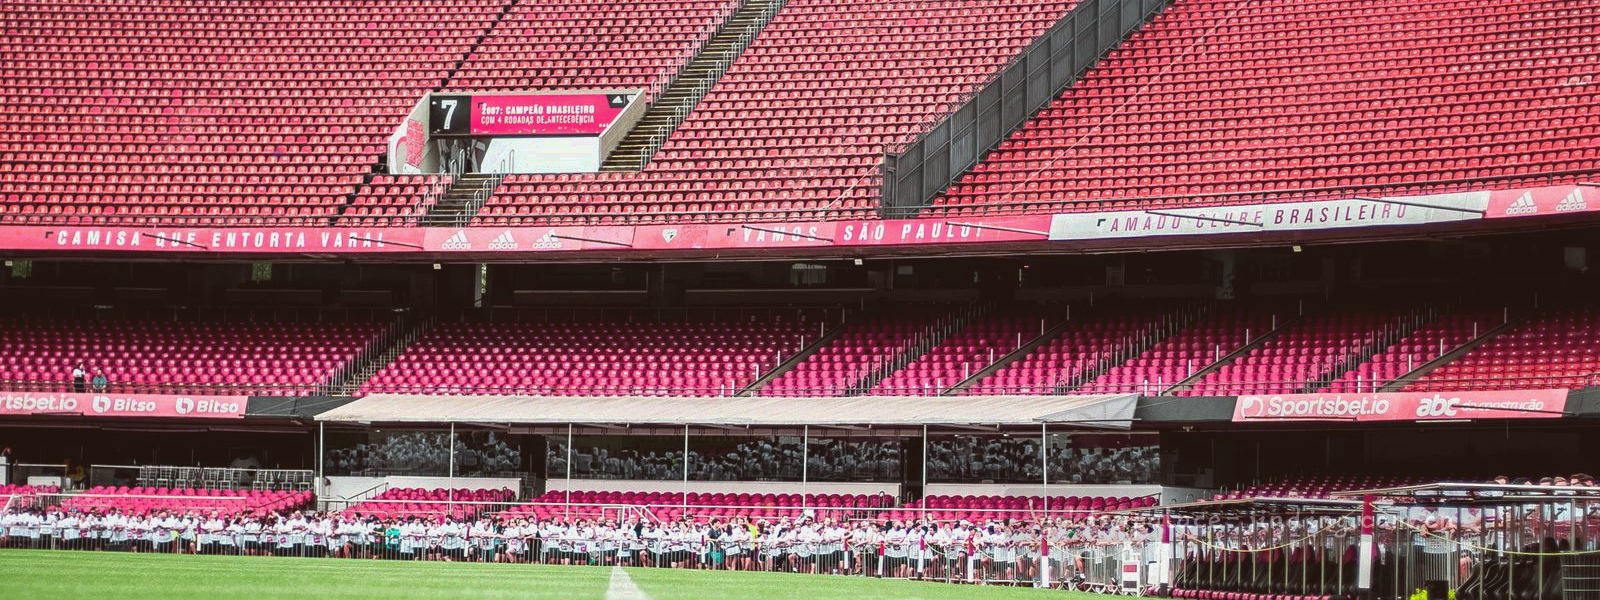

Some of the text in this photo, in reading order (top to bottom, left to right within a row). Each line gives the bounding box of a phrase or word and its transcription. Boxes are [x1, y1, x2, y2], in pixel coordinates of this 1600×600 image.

[441, 99, 458, 130] 7
[505, 104, 544, 115] CAMPEÃO
[546, 105, 595, 115] BRASILEIRO
[480, 116, 496, 126] COM
[497, 116, 502, 124] 4
[504, 115, 534, 125] RODADAS
[1506, 205, 1538, 215] adidas
[1556, 201, 1588, 211] adidas
[1110, 202, 1407, 232] AMADO CLUBE BRASILEIRO
[57, 230, 385, 248] CAMISA QUE ENTORTA VARAL
[743, 221, 983, 242] VAMOS SÃO PAULO!
[441, 241, 472, 250] adidas
[488, 241, 519, 250] adidas
[532, 240, 563, 249] adidas
[113, 397, 156, 412] Bitso
[196, 399, 239, 414] Bitso
[1267, 395, 1390, 416] Sportsbet.io
[1415, 393, 1461, 417] abc
